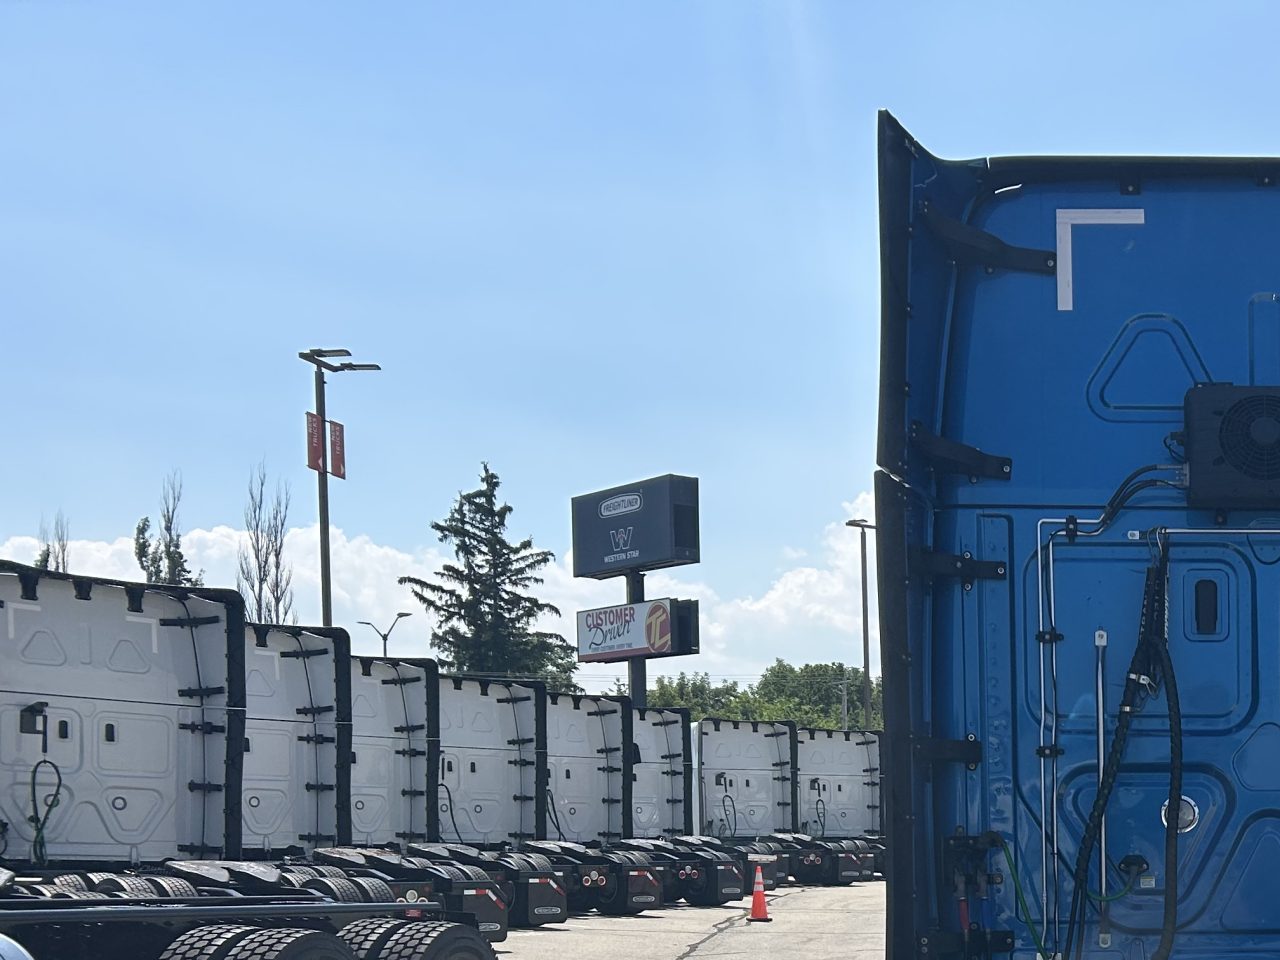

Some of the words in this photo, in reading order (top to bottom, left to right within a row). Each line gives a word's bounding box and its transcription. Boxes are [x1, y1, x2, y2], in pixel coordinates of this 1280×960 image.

[604, 552, 626, 563] WESTERN
[626, 550, 640, 560] STAR
[586, 606, 635, 628] CUSTOMER
[589, 621, 630, 649] Driven
